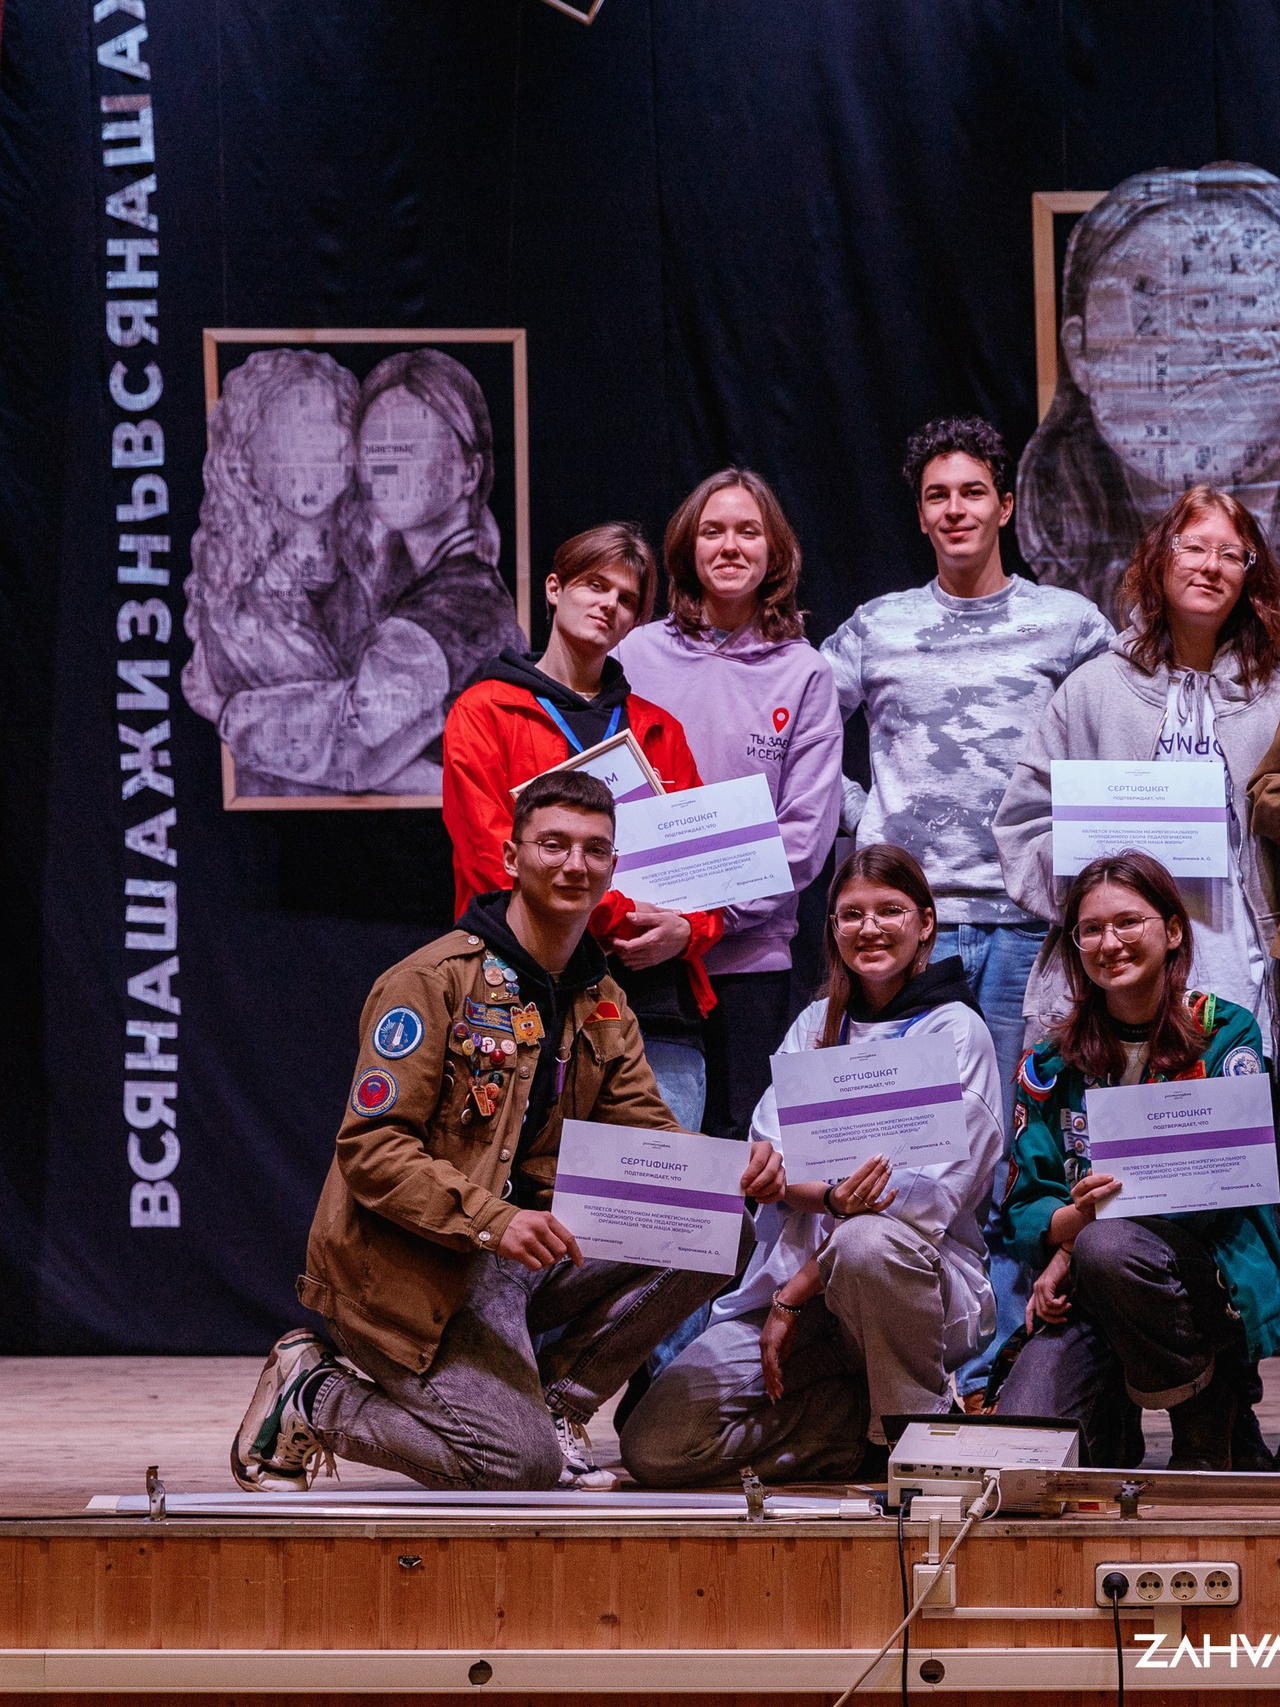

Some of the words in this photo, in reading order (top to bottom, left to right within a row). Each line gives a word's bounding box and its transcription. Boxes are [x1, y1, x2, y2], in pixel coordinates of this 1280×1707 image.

[94, 0, 182, 1228] ВСЯНАШАЖИЗНЬВСЯНАША
[750, 733, 766, 746] ТЫ
[767, 736, 790, 750] ЗДЕ
[746, 745, 756, 757] И
[758, 748, 785, 761] СЕЙ
[657, 811, 719, 831] СЕРТИФИКАТ
[833, 1068, 899, 1084] СЕРТИФИКАТ
[840, 1082, 884, 1093] ПОДТВЕРЖДАЕТ,
[1147, 1108, 1213, 1121] СЕРТИФИКАТ
[1153, 1122, 1198, 1130] ПОДТВЕРЖДАЕТ,
[621, 1157, 688, 1172] СЕРТИФИКАТ
[624, 1170, 670, 1181] ПОДТВЕРЖДАЕТ,
